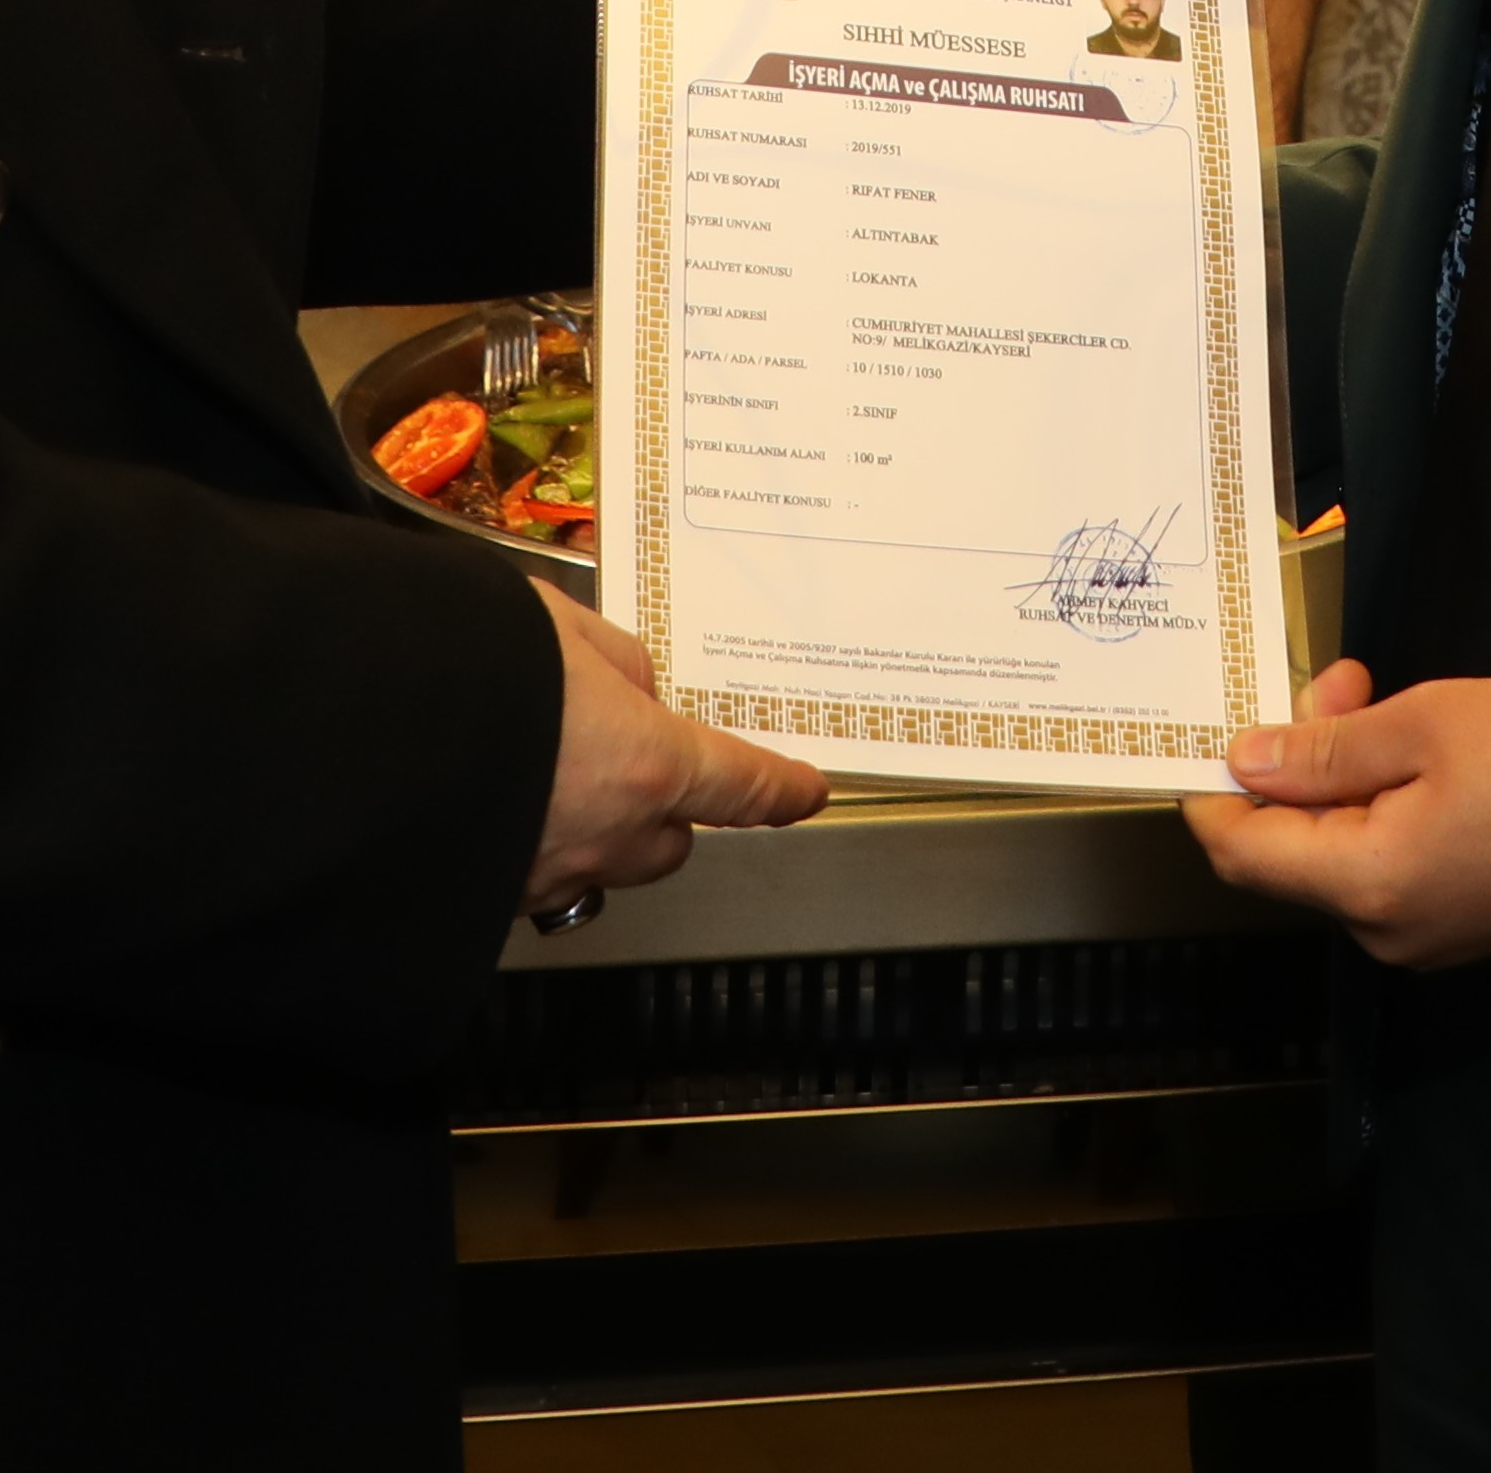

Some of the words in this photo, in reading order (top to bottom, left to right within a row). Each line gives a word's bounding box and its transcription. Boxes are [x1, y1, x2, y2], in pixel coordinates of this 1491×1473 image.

[843, 23, 903, 46] SIHHİ
[910, 29, 1027, 59] MÜESSESE
[688, 84, 739, 100] RUHSAT
[741, 89, 784, 104] TARİHİ
[852, 99, 912, 116] 13.12.2019
[788, 59, 845, 89] İŞYERİ
[849, 70, 900, 95] AÇMA
[904, 79, 925, 96] ve
[928, 78, 1006, 105] ÇALIŞMA
[1010, 86, 1085, 112] RUHSATI
[688, 127, 739, 143] RUHSAT
[740, 132, 808, 149] NUMARASI
[851, 141, 902, 157] 2019/551
[687, 171, 710, 183] ADI
[712, 173, 730, 185] VE
[732, 175, 781, 190] SOYADI
[852, 184, 891, 199] RIFAT
[894, 188, 938, 203] FENER
[686, 213, 723, 229] İŞYERİ
[726, 219, 772, 232] UNVANI
[852, 228, 940, 246] ALTINTABAK
[685, 258, 742, 275] FAALİYET
[744, 264, 794, 278] KONUSU
[852, 271, 918, 289] LOKANTA
[685, 303, 722, 319] İŞYERİ
[725, 308, 768, 322] ADRESİ
[852, 316, 943, 336] CUMHURİYET
[946, 324, 1025, 343] MAHALLESİ
[1027, 331, 1108, 349] ŞEKERCİLER
[1110, 337, 1133, 351] CD.
[852, 332, 887, 347] NO:9/
[893, 336, 1031, 358] MELİKGAZİ/KAYSERİ
[684, 349, 721, 363] PAFTA
[731, 353, 756, 365] ADA
[765, 356, 808, 370] PARSEL
[853, 362, 866, 373] 10
[877, 363, 905, 377] 1510
[915, 366, 943, 380] 1030
[684, 390, 743, 408] İŞYERİNİN
[745, 398, 779, 411] SINIFI
[853, 405, 898, 420] 2.SINIF
[685, 437, 722, 453] İŞYERİ
[725, 442, 788, 458] KULLANIM
[790, 449, 826, 461] ALANI
[854, 452, 874, 465] 100
[685, 484, 721, 499] DİĞER
[723, 488, 781, 505] FAALİYET
[783, 494, 832, 509] KONUSU
[1019, 608, 1072, 623] RUHSAT
[1078, 611, 1096, 624] VE
[1163, 616, 1207, 631] MÜD.V
[1108, 597, 1169, 613] KAHVECİ
[702, 644, 727, 656] İşyeri
[729, 648, 754, 660] Açma
[768, 653, 803, 665] Çalışma
[805, 657, 849, 667] Ruhsatına
[880, 662, 930, 673] yönetmelik
[932, 666, 987, 677] kapsamında
[703, 632, 746, 645] 14.7.2005
[747, 637, 775, 648] tarihli
[864, 647, 903, 658] Bakanlar
[905, 651, 935, 662] Kurulu
[966, 654, 976, 664] ile
[978, 656, 1022, 668] yürürlüğe
[1024, 658, 1061, 669] konulan
